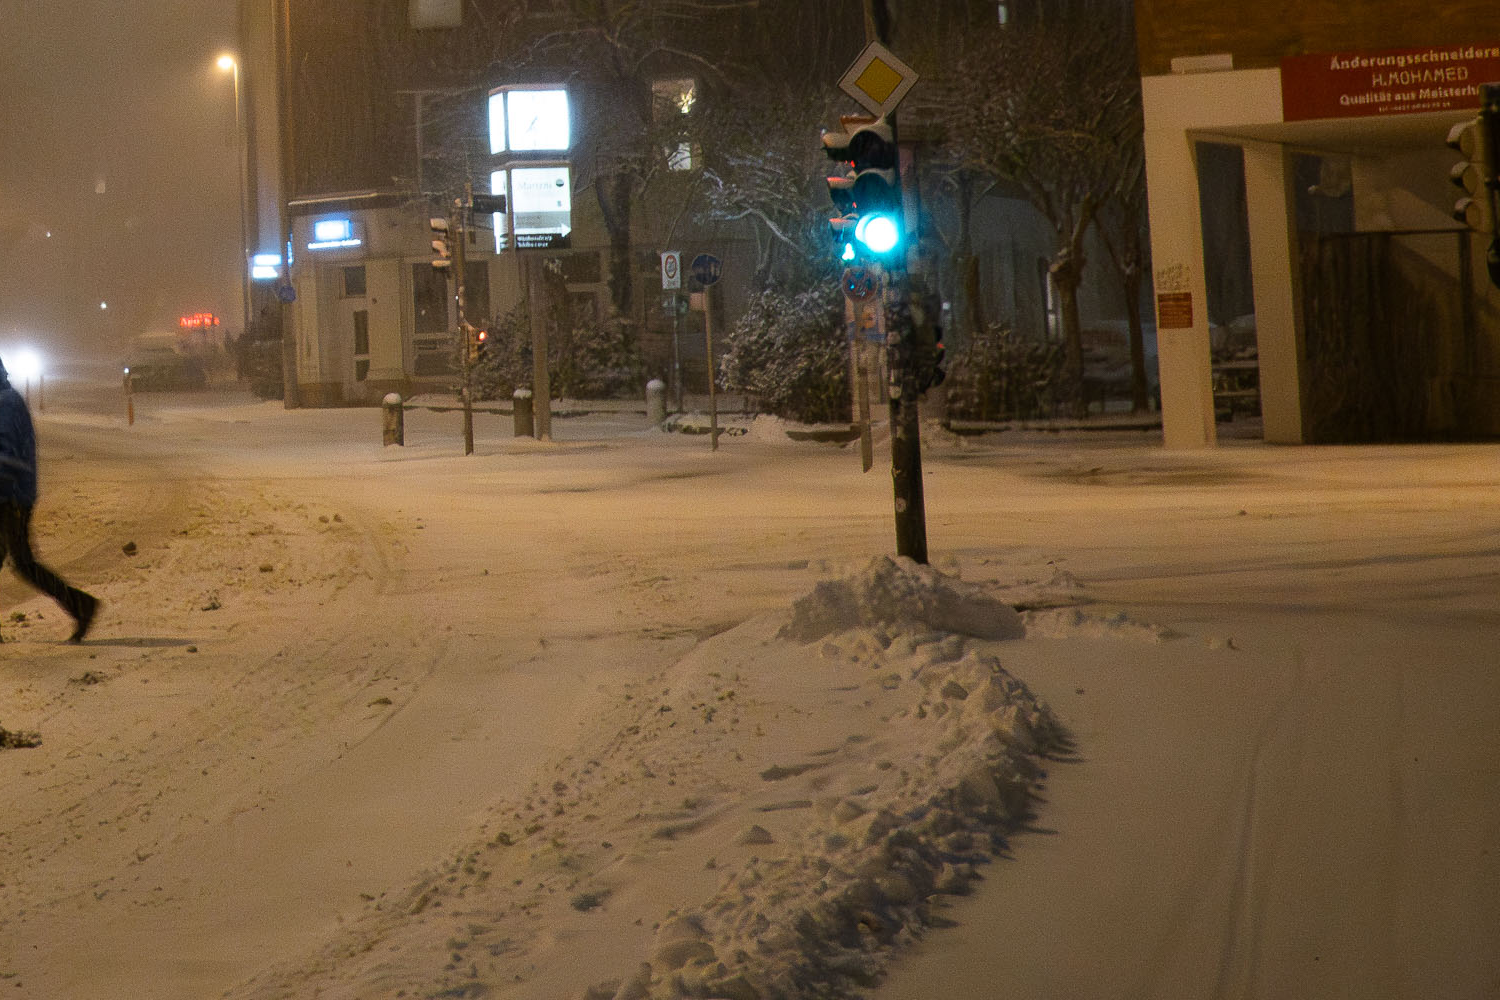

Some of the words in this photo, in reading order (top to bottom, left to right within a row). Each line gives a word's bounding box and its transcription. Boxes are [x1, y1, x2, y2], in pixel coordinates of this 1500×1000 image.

[1371, 66, 1468, 87] H.MOHAMED
[1339, 92, 1392, 106] Qualität
[1394, 91, 1416, 101] aus
